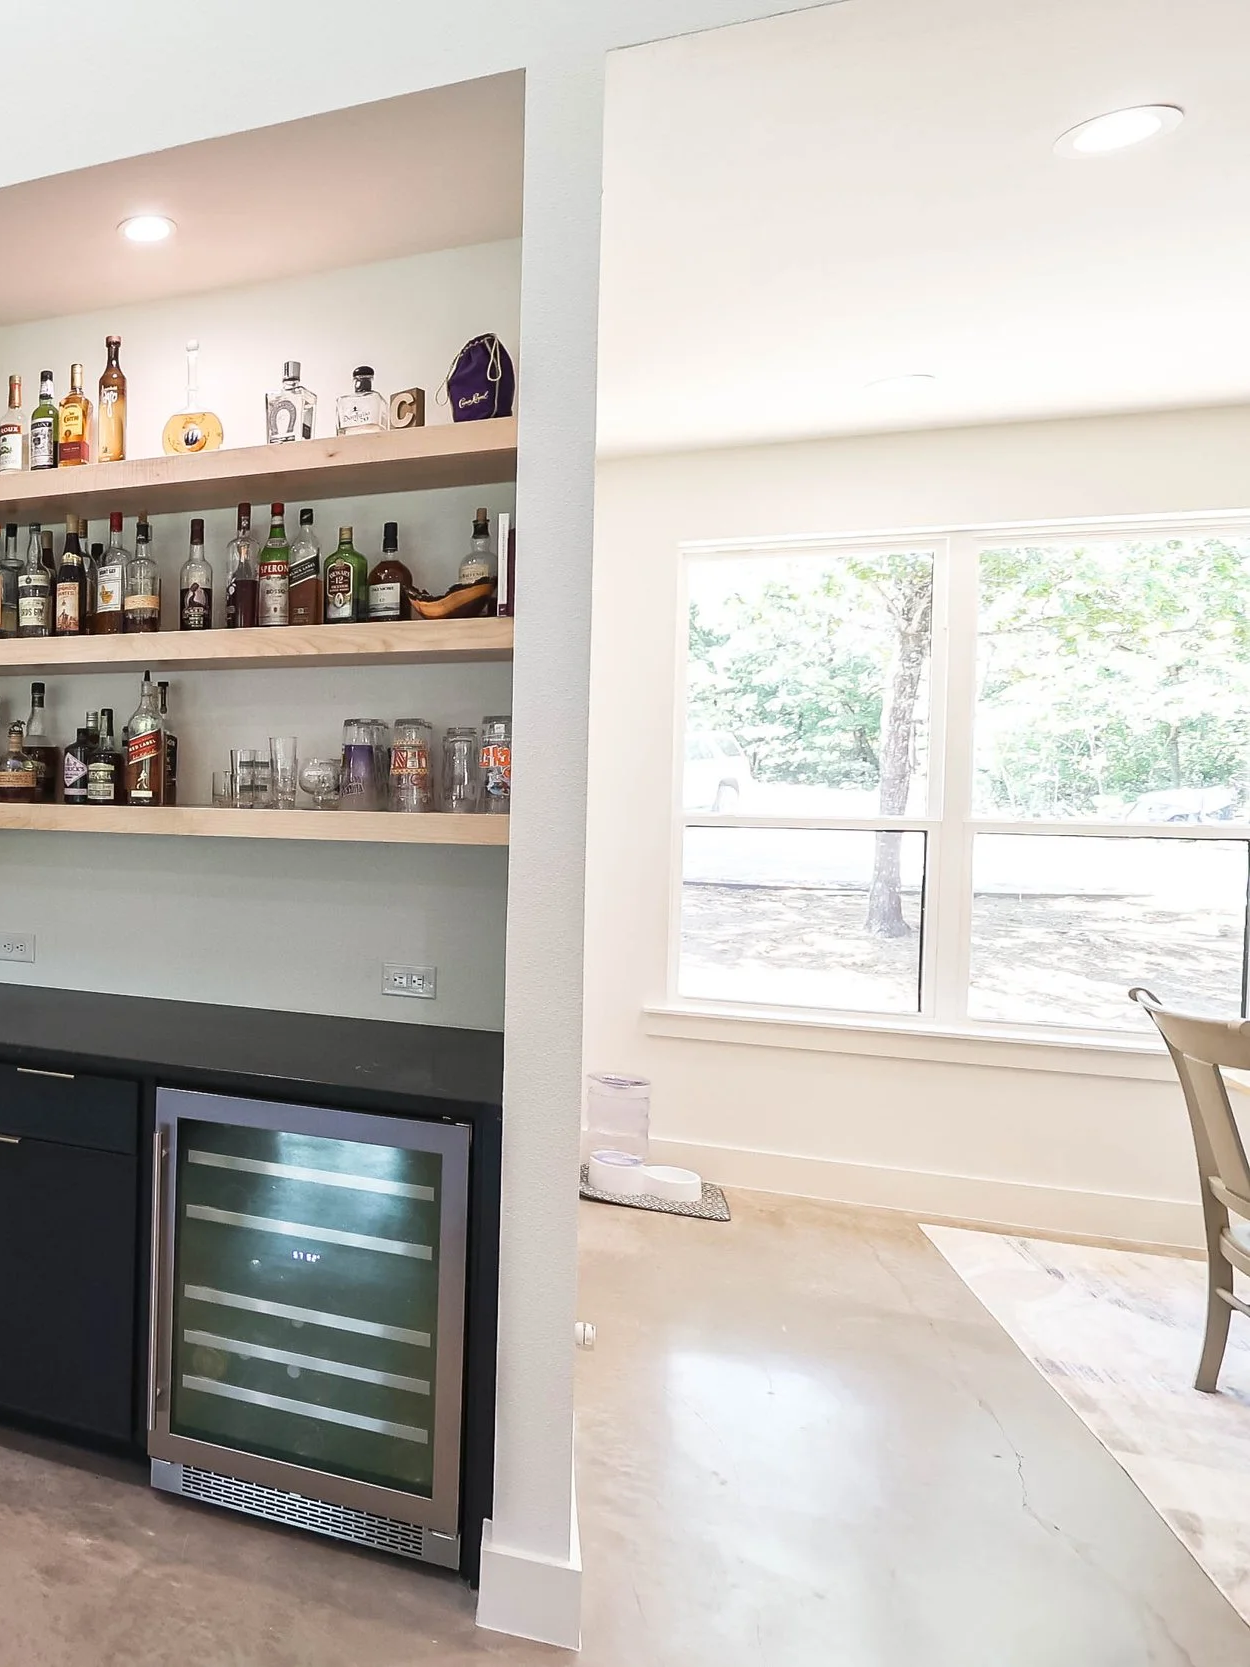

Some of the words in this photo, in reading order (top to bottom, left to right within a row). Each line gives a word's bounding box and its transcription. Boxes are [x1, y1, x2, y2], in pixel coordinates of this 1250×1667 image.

[390, 392, 415, 428] C
[335, 575, 344, 584] 12
[139, 739, 156, 748] LABEL
